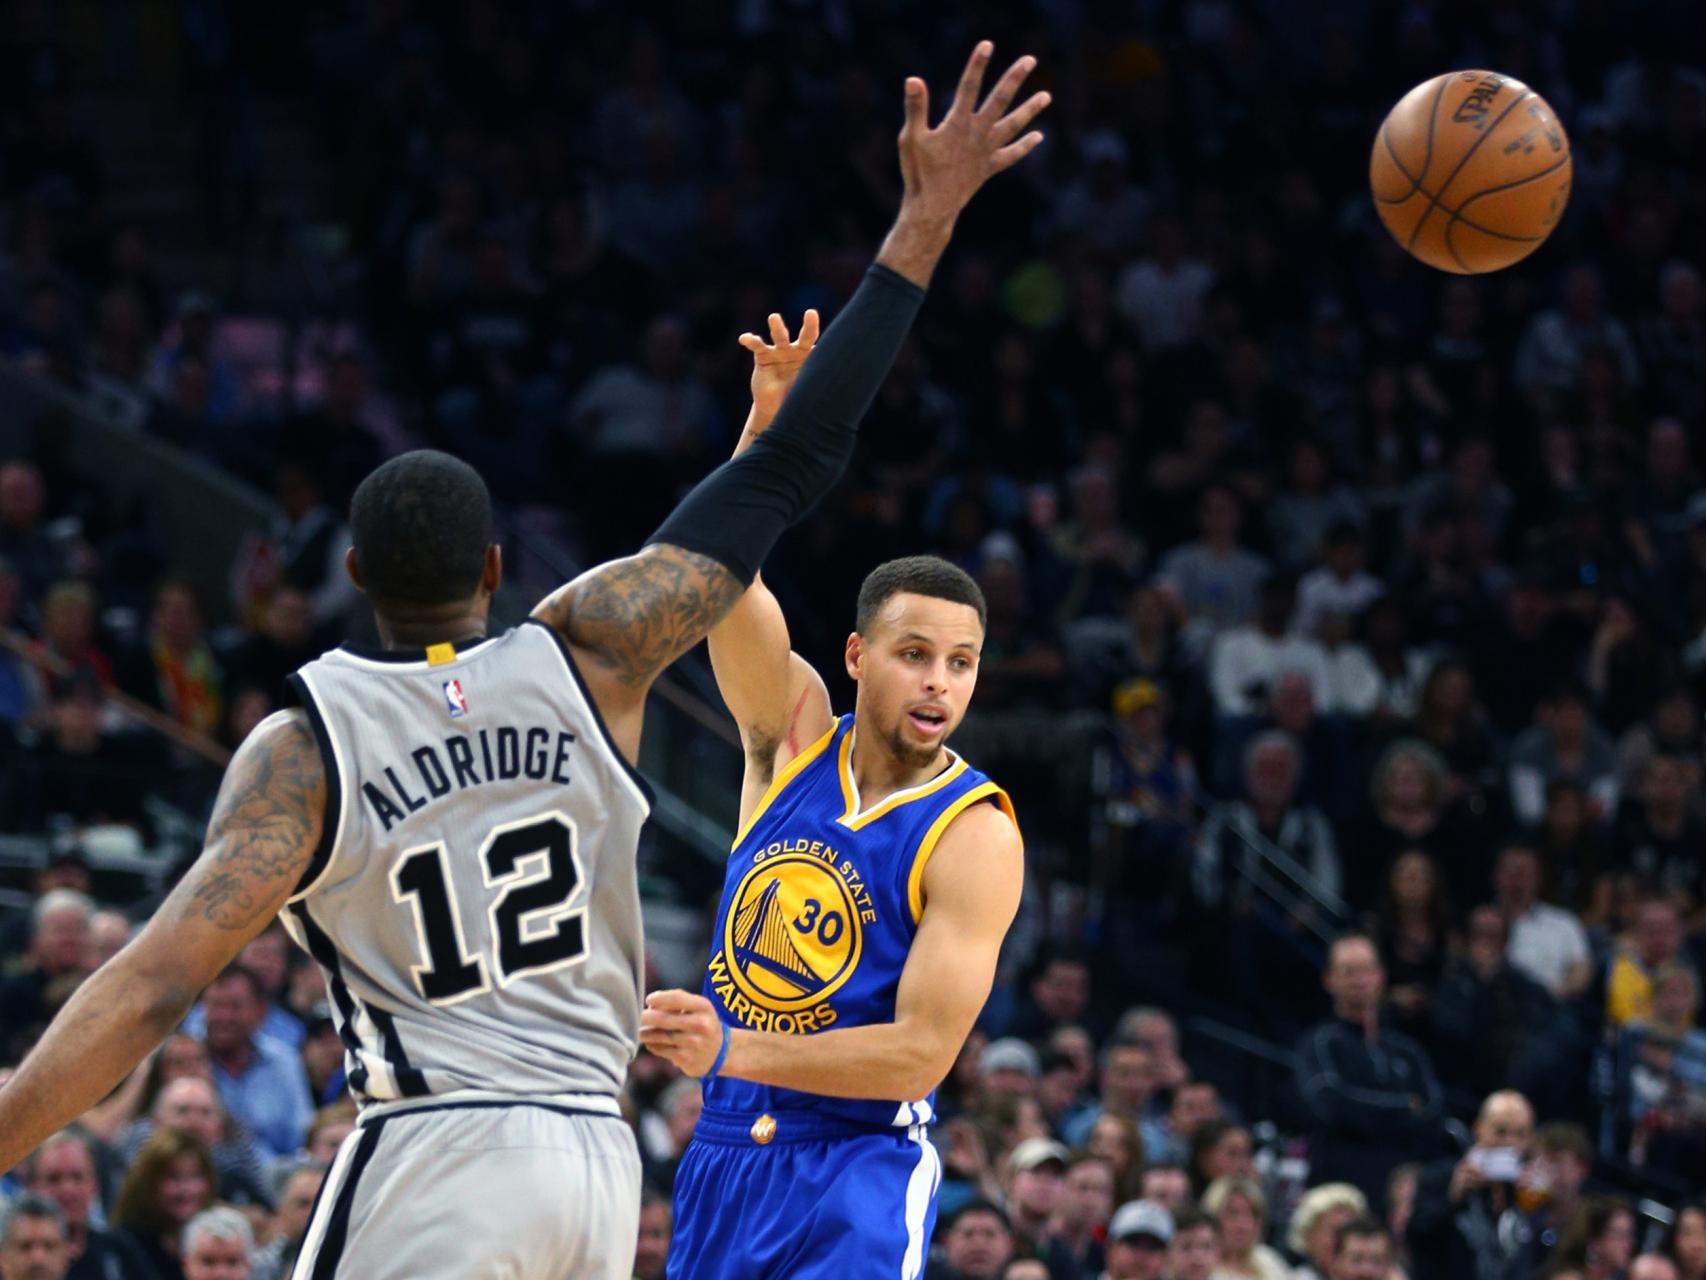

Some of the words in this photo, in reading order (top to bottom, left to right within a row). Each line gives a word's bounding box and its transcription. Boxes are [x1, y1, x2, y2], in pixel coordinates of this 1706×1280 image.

[362, 726, 575, 831] ALDRIDGE
[389, 810, 590, 1006] 12
[753, 838, 838, 864] GOLDEN
[839, 860, 877, 924] STATE
[793, 898, 844, 946] 30
[708, 950, 838, 1035] WARRIORS
